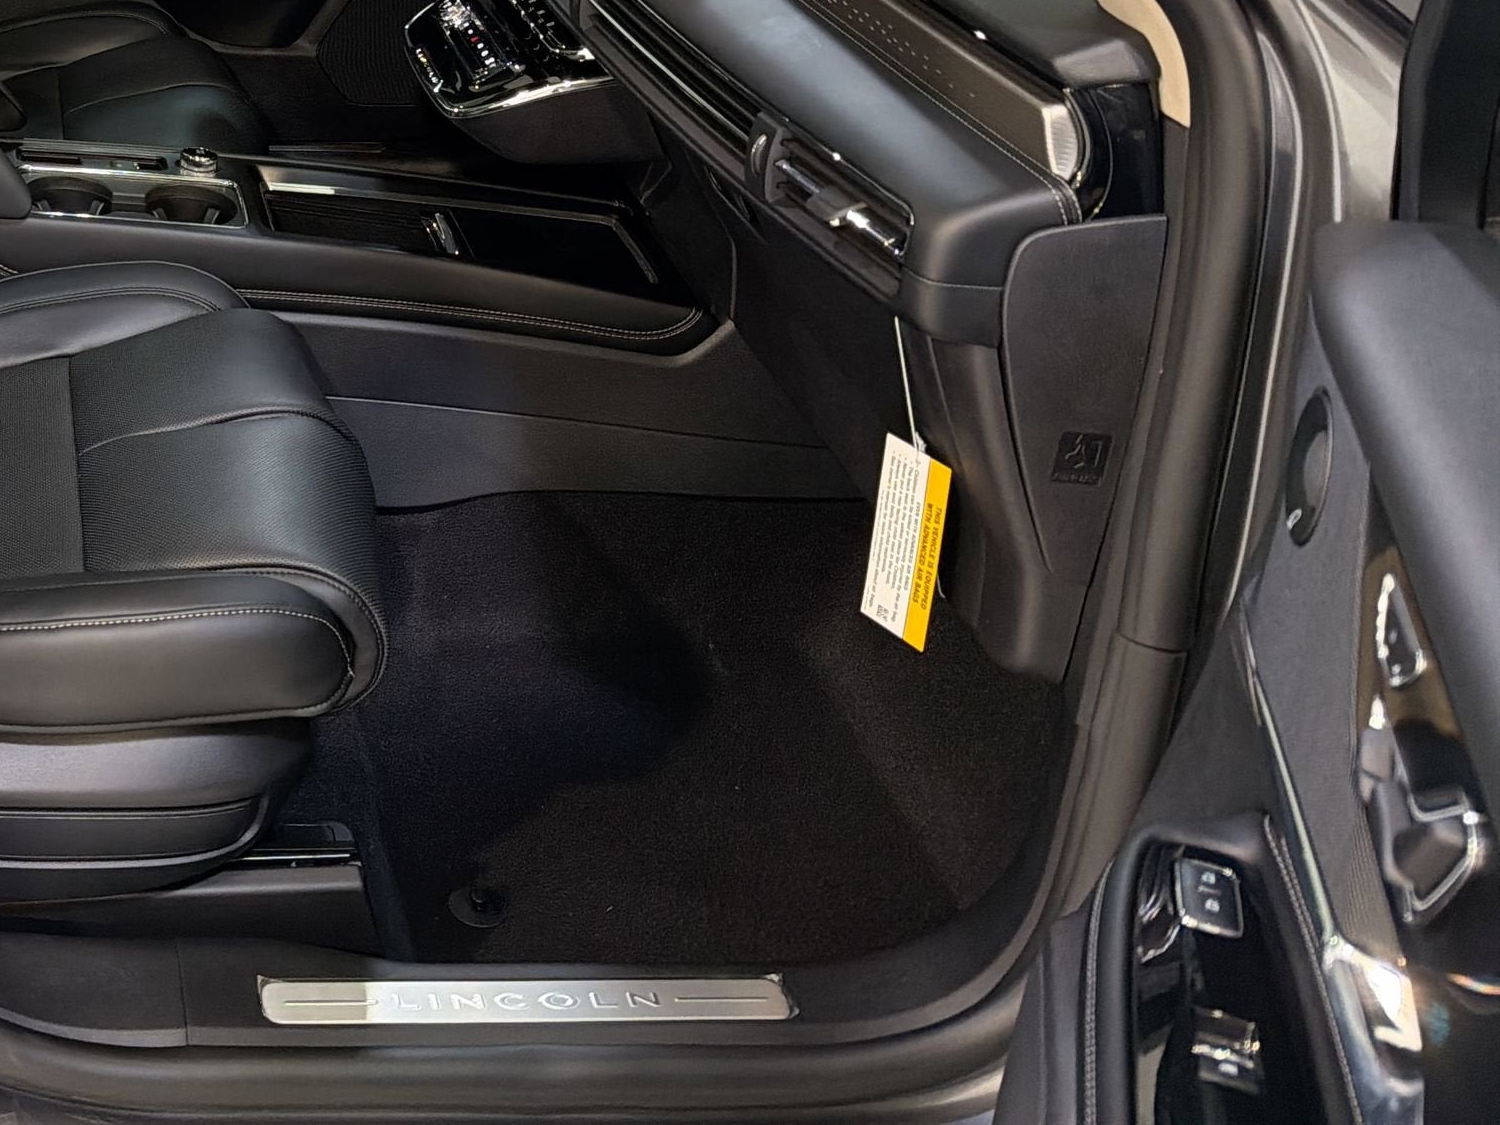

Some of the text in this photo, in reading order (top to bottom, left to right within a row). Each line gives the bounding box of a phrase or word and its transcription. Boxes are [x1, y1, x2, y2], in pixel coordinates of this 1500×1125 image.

[925, 502, 934, 524] WITH
[934, 506, 942, 526] THIS
[918, 524, 930, 566] ADVANCED
[929, 527, 939, 560] VEHICLE
[912, 581, 921, 604] BAGS
[920, 570, 932, 611] EQUIPPED
[391, 990, 660, 1011] LINCOLN
